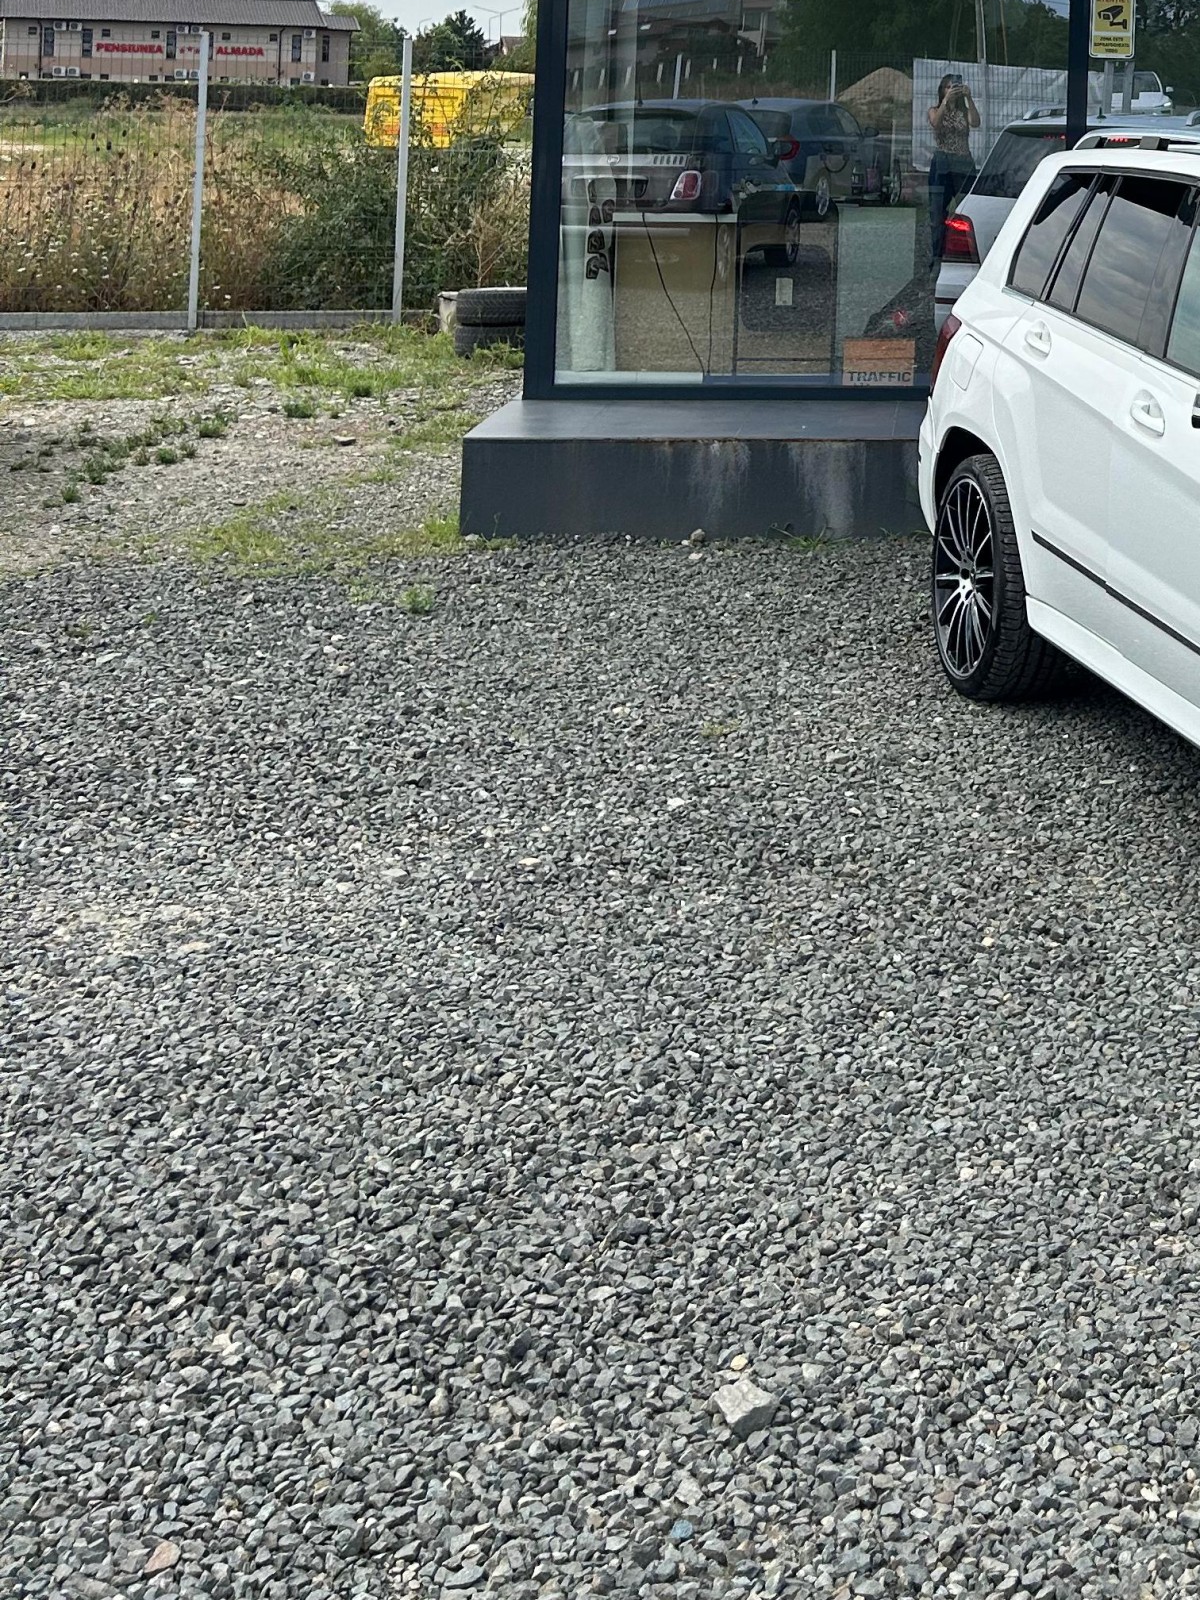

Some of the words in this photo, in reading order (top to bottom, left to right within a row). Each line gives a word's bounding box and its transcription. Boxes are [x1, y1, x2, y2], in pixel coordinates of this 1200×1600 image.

[95, 42, 165, 55] PENSIUNEA
[216, 46, 265, 57] ALMADA
[847, 371, 912, 383] TRAFFIC
